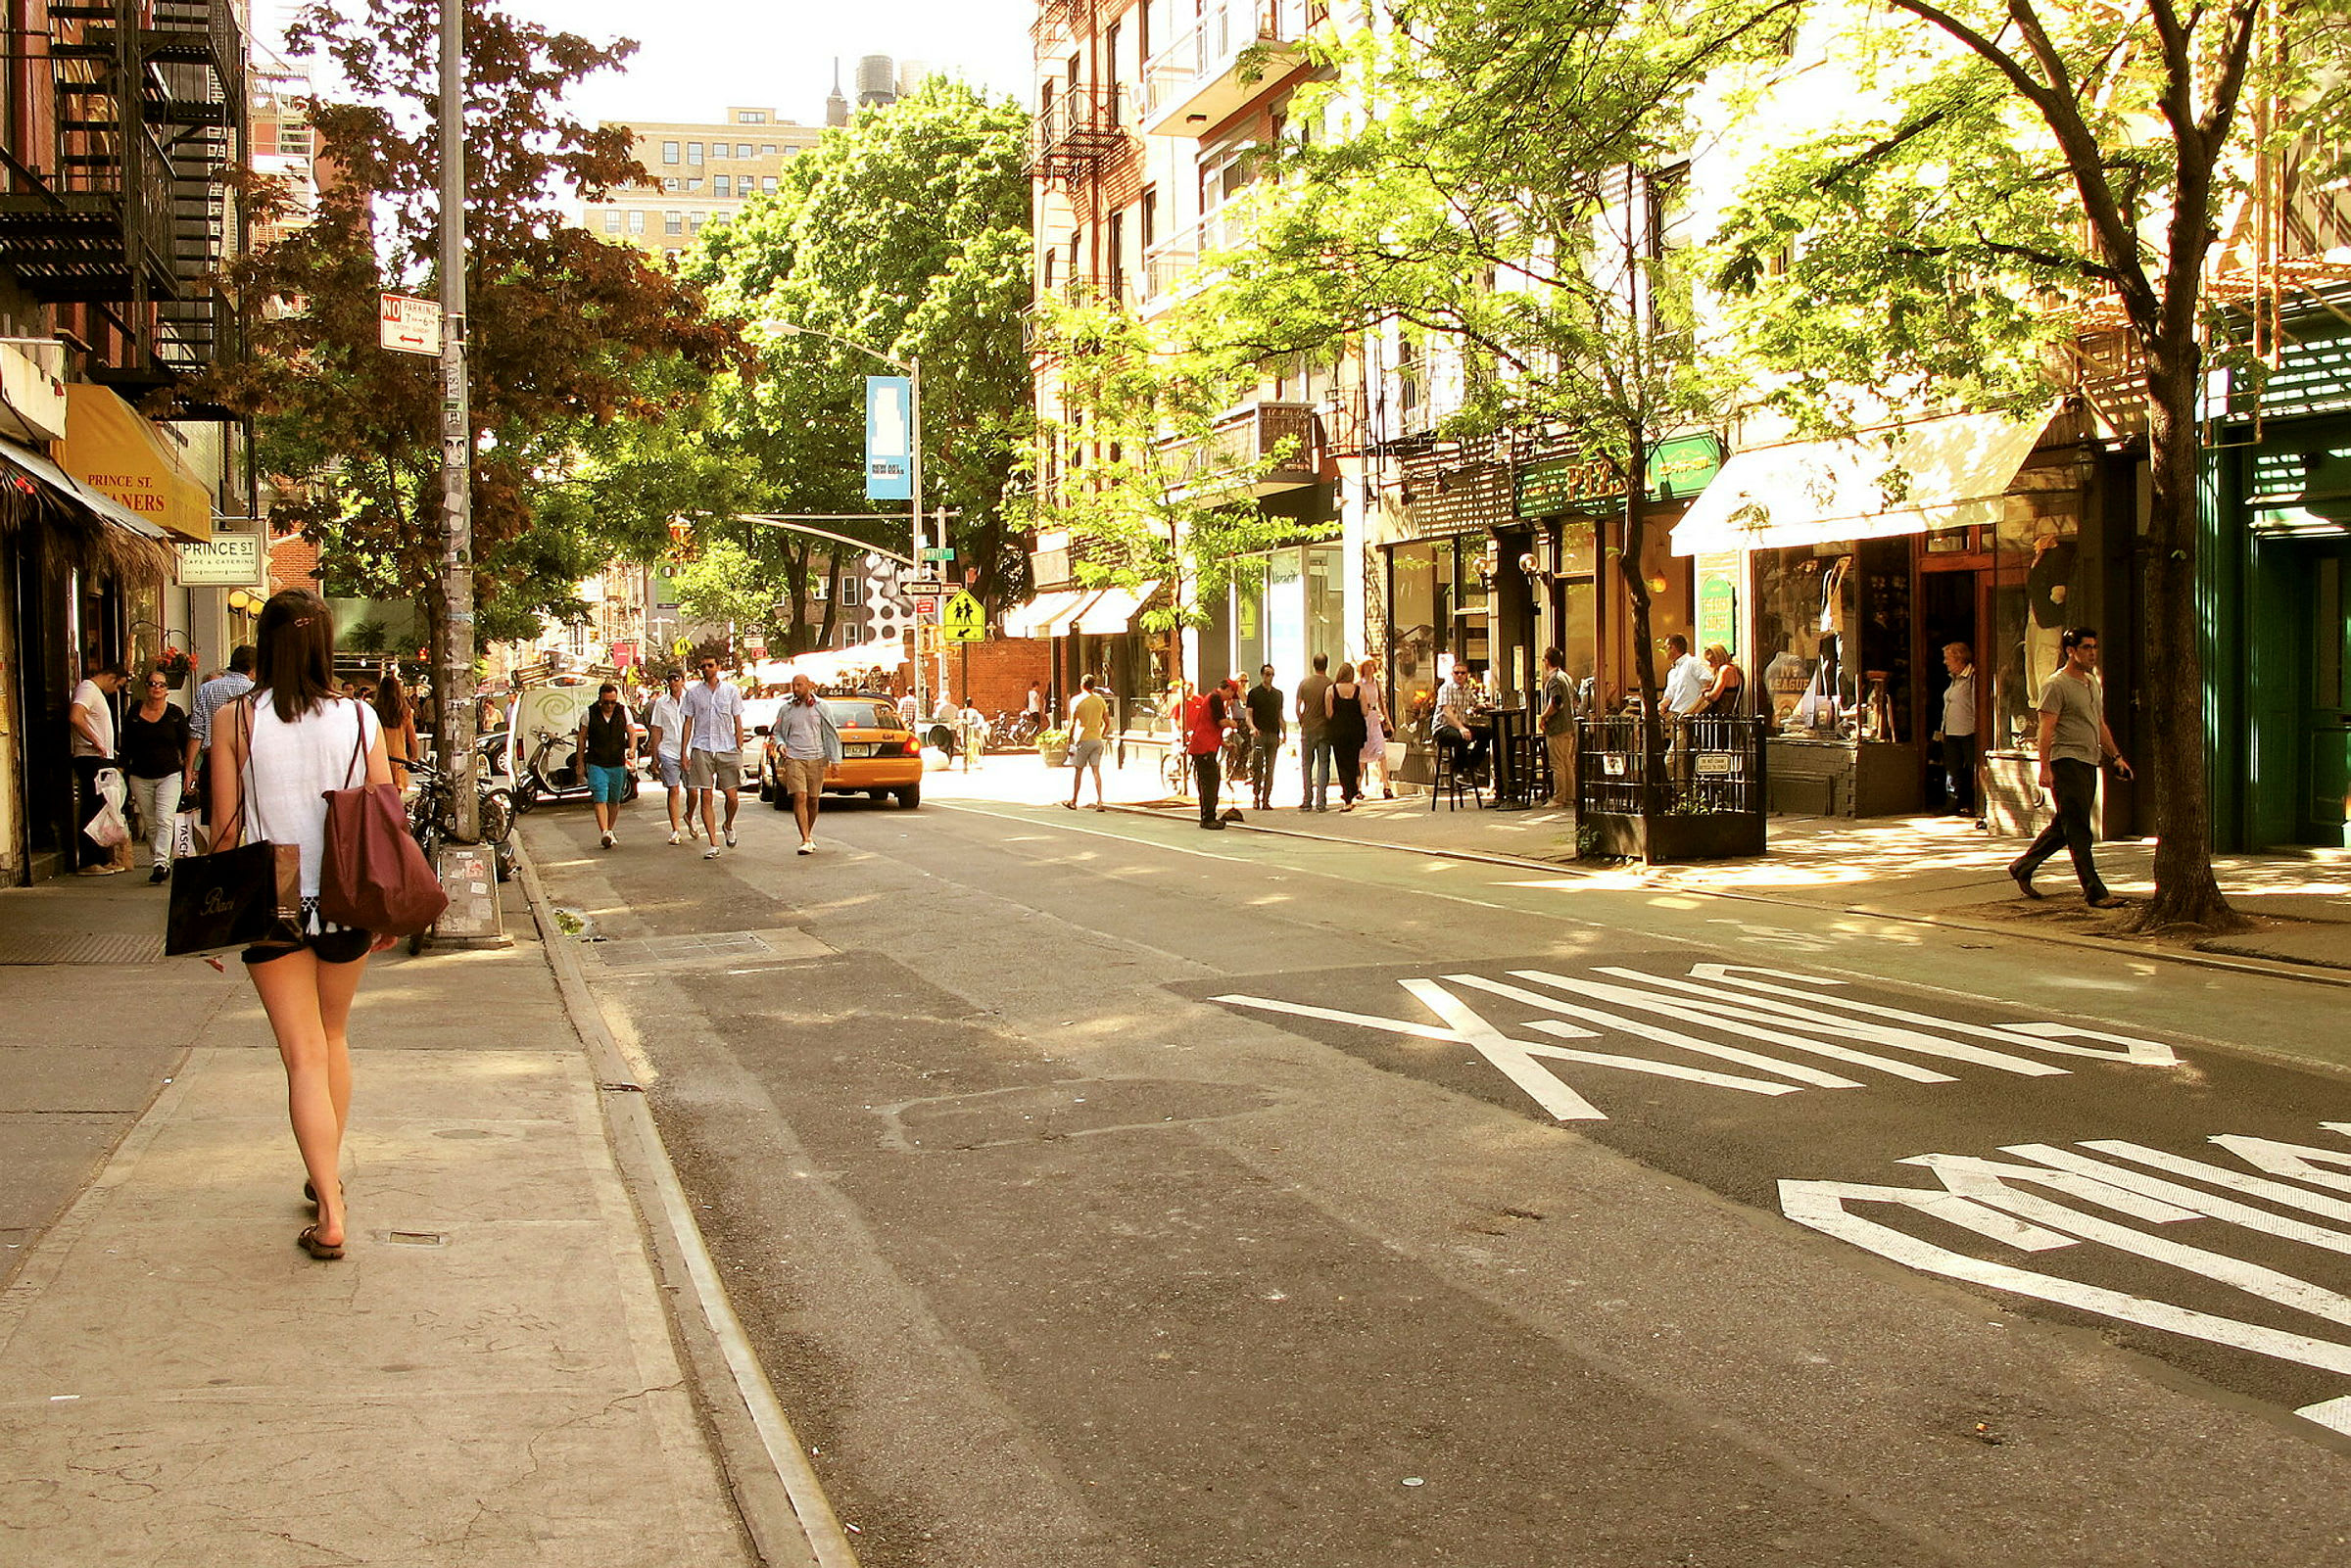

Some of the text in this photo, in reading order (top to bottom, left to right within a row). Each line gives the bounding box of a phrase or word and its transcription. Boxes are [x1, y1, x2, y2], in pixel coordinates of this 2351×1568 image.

[383, 299, 438, 318] NO PARKING
[88, 474, 153, 488] PRINCE ST.
[183, 542, 254, 556] PRINCE ST
[1768, 678, 1810, 690] LEAGUE
